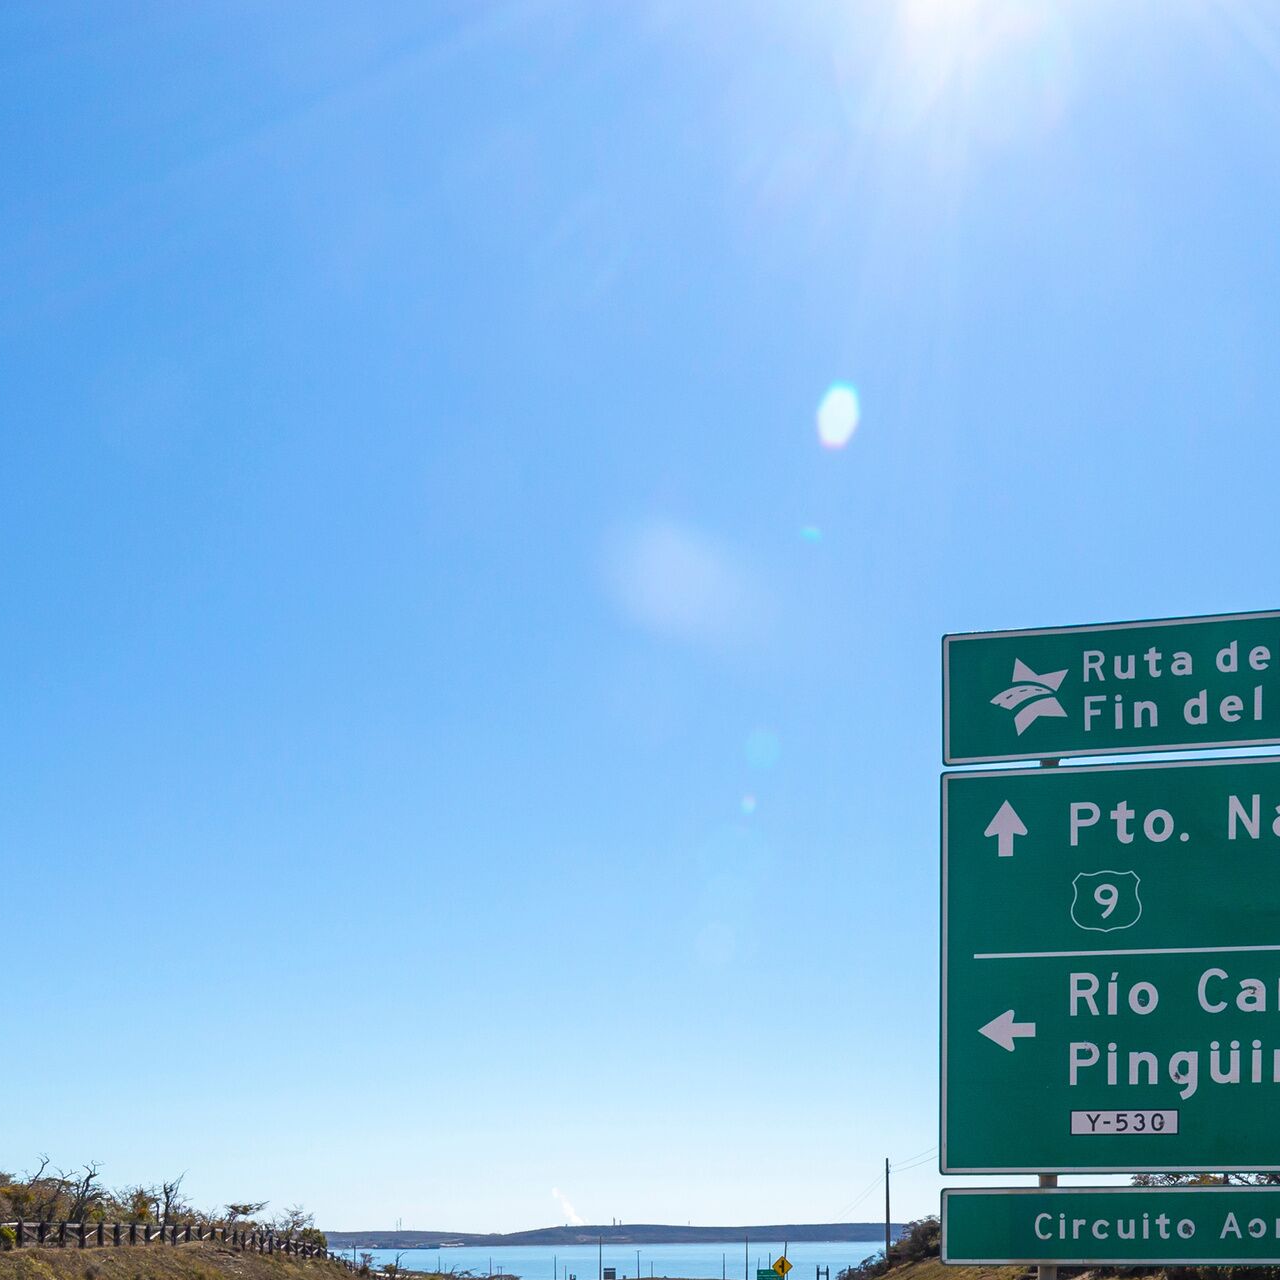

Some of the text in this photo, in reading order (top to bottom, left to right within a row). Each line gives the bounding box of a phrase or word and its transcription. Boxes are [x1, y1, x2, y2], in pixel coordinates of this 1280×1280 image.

[1084, 647, 1193, 682] Ruta
[1083, 695, 1159, 731] Fin
[1183, 686, 1263, 725] del
[1070, 800, 1190, 846] Pto.
[1094, 884, 1119, 918] 9
[1070, 972, 1159, 1017] Río
[1086, 1113, 1165, 1132] Y-530
[1034, 1213, 1196, 1240] Circuito
